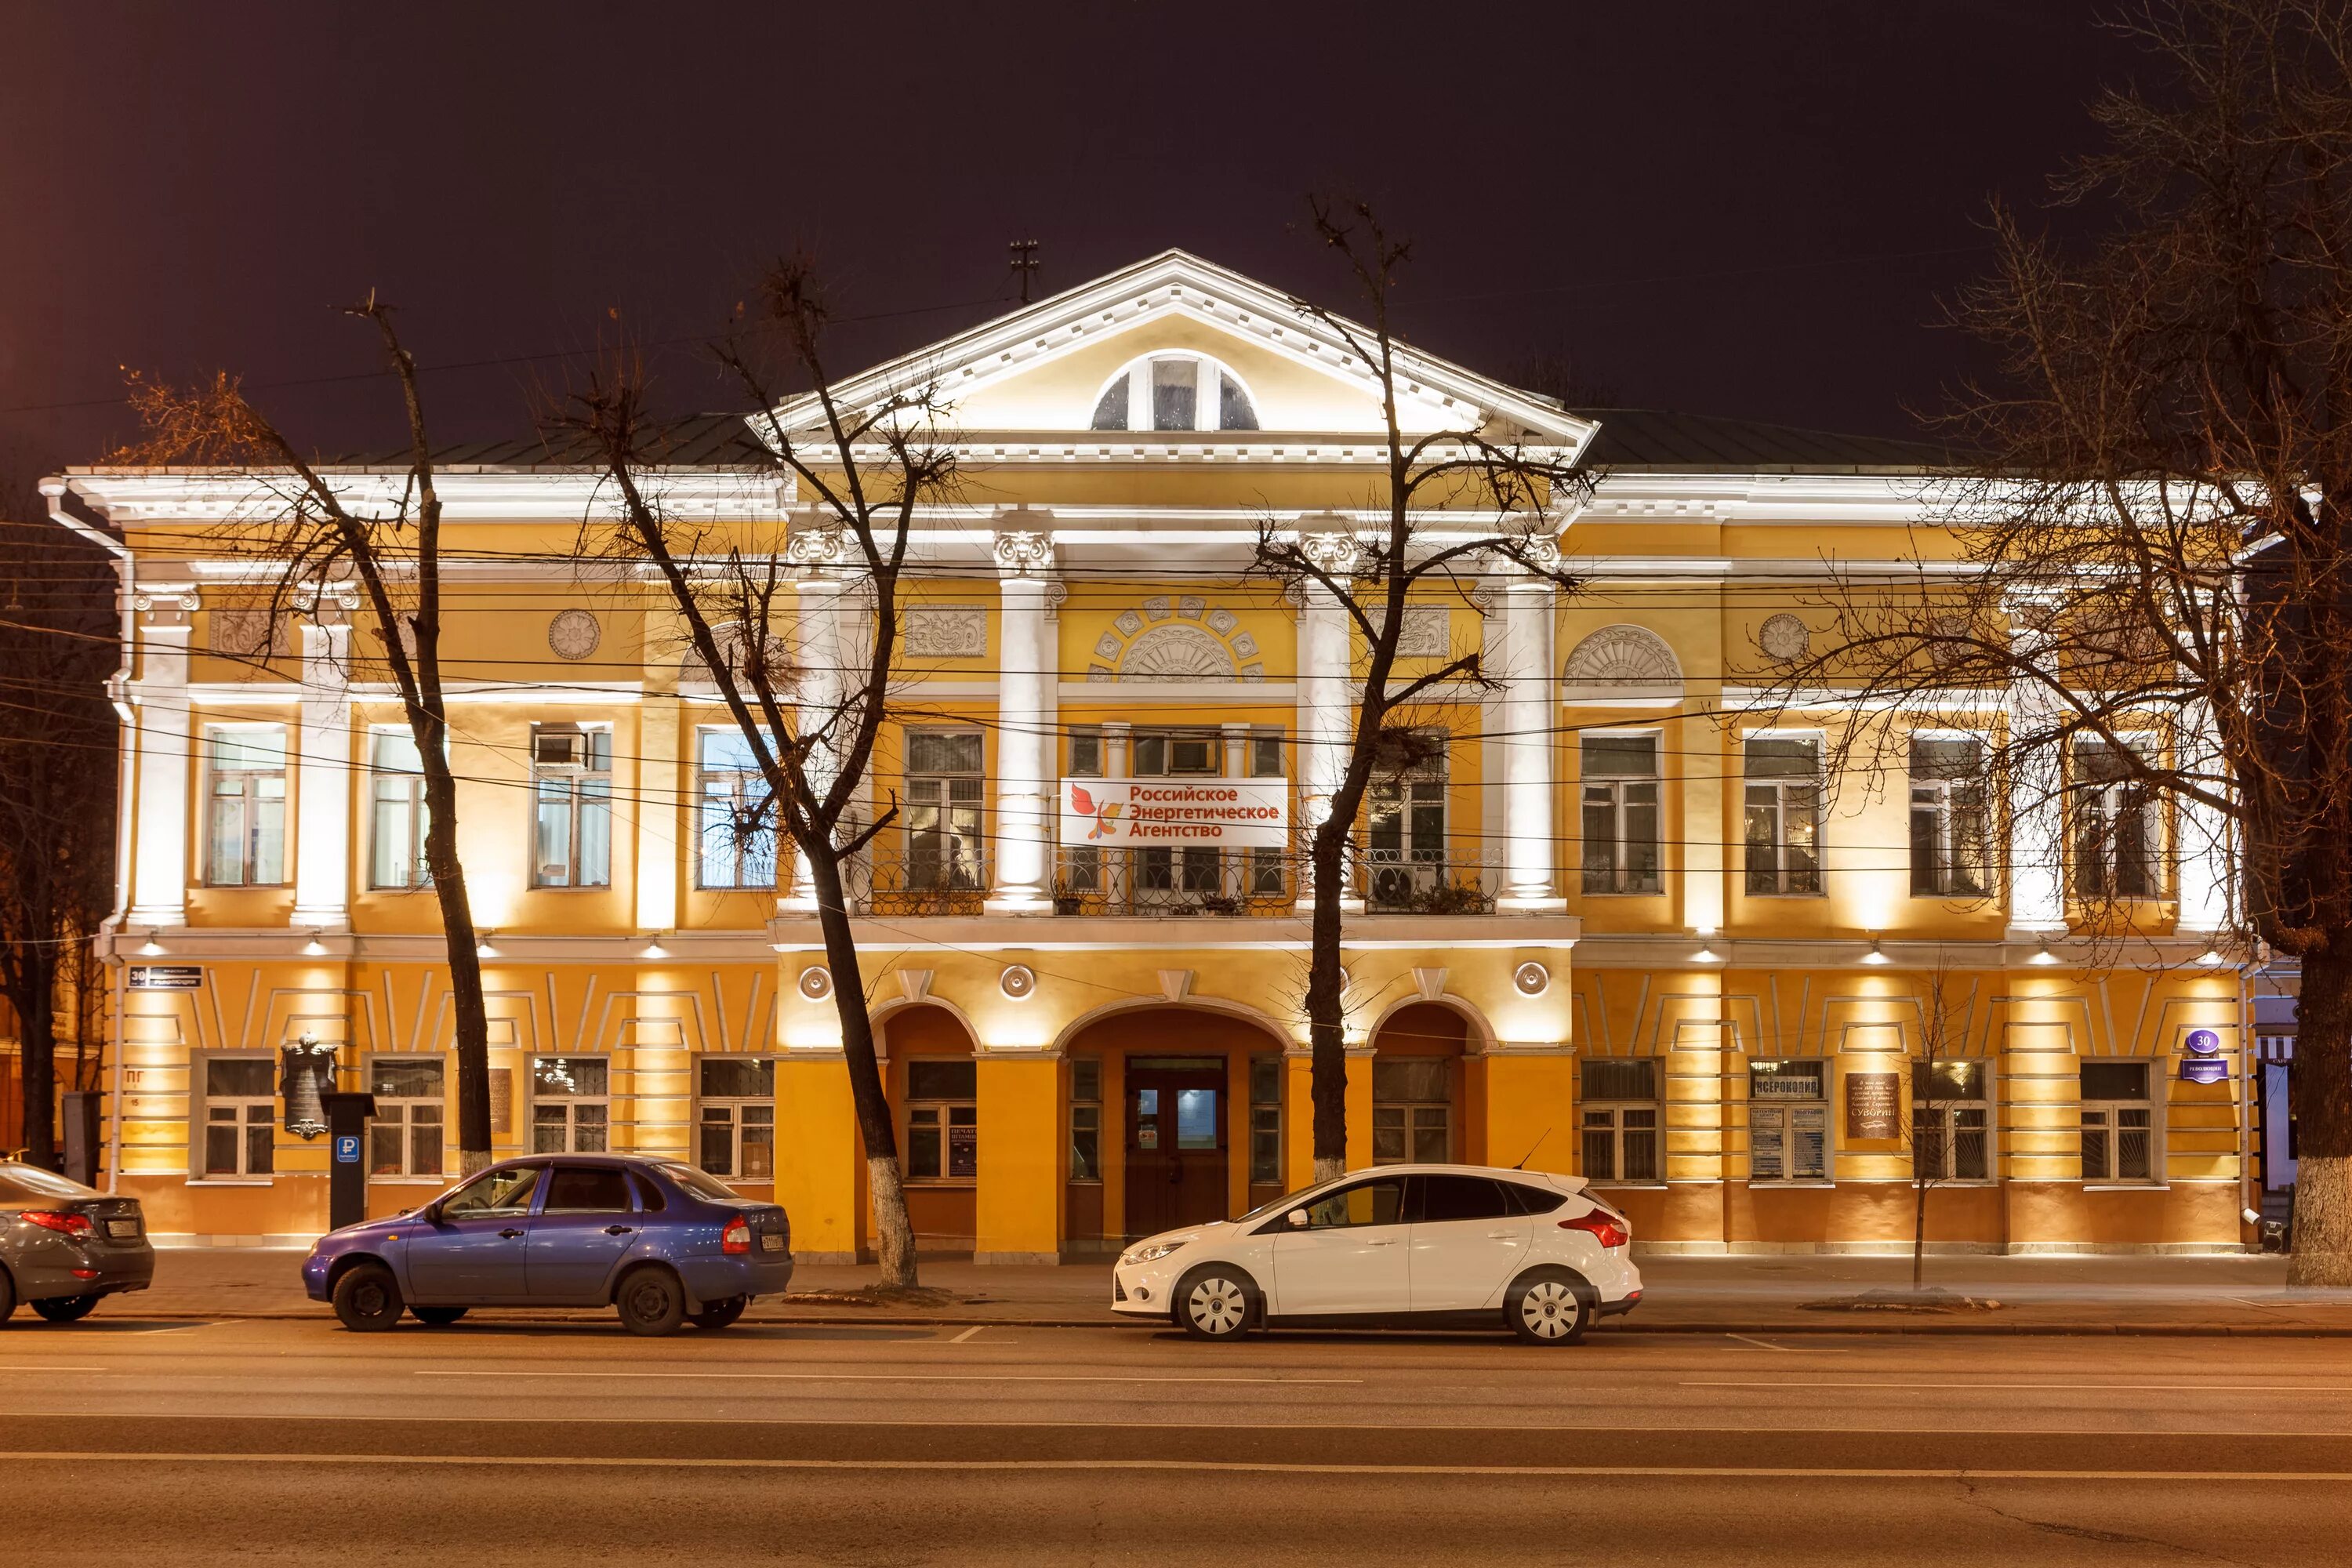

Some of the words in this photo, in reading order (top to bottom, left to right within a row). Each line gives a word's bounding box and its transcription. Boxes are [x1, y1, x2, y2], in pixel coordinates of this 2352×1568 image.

[1129, 786, 1238, 801] Российское
[1129, 804, 1279, 822] Энергетическое
[1129, 823, 1222, 837] Агентство
[131, 971, 146, 981] 30
[2197, 1036, 2211, 1047] 30
[127, 1071, 144, 1083] ПГ
[1756, 1081, 1817, 1093] КСЕРОКОПИЯ
[1851, 1108, 1895, 1116] СУВОРИН
